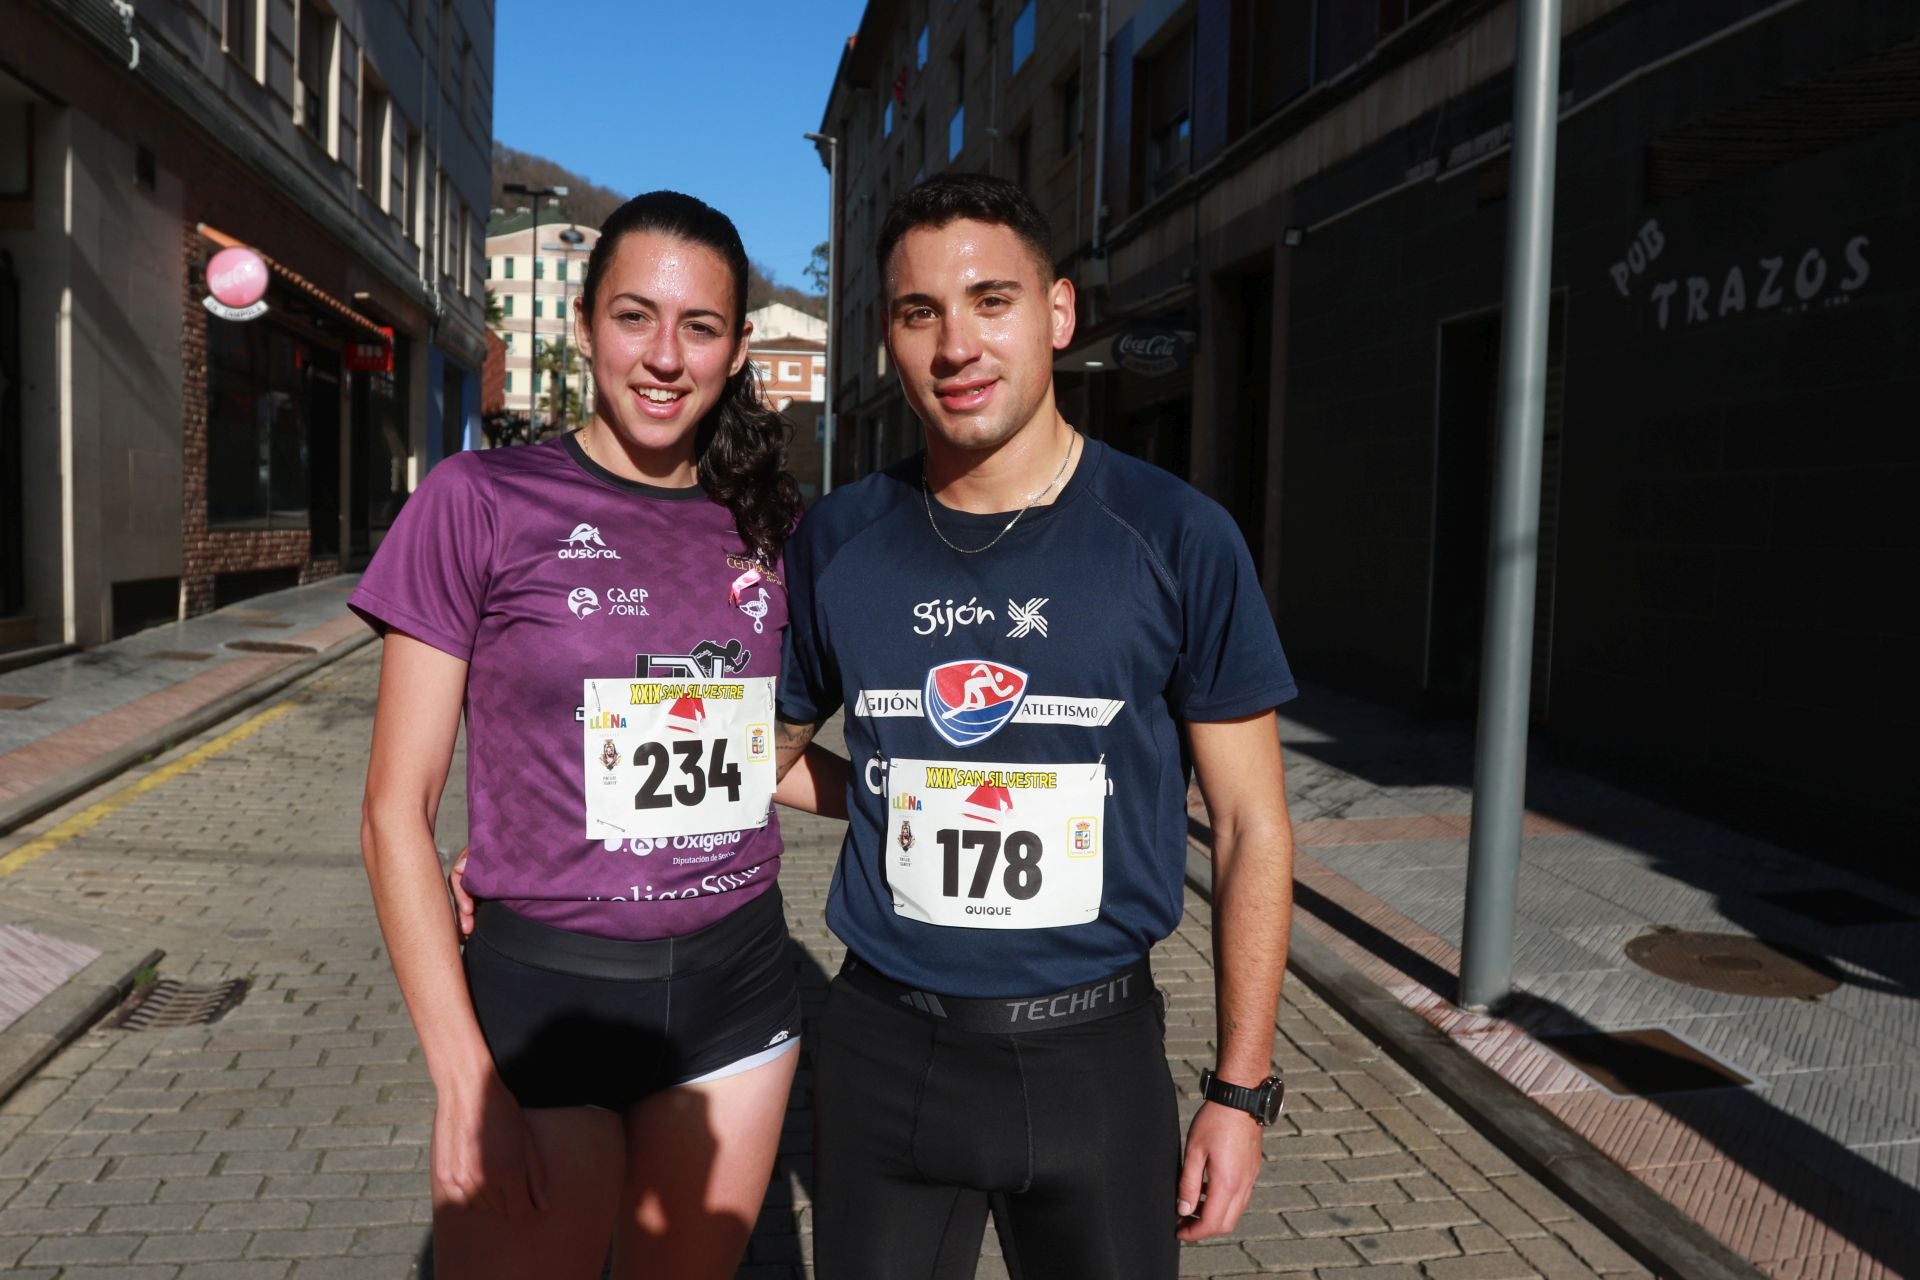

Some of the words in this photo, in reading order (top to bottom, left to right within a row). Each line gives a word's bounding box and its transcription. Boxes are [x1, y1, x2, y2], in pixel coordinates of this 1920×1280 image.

[1608, 218, 1666, 297] PUB
[1650, 234, 1872, 331] TRAZOS
[630, 684, 661, 705] XXIX
[661, 684, 685, 700] SAN
[686, 684, 745, 700] SILVESTRE
[867, 692, 919, 713] GIJÓN
[589, 711, 627, 729] LLENA
[1021, 703, 1099, 719] ATLETISMO
[633, 738, 742, 810] 234
[926, 767, 958, 789] XXIX
[957, 770, 985, 787] SAN
[988, 770, 1058, 789] SILVESTRE
[892, 791, 923, 811] LLENA
[672, 855, 710, 866] Diputación
[710, 853, 719, 862] de
[936, 828, 1043, 900] 178
[965, 905, 1012, 916] QUIQUE
[1006, 973, 1134, 1023] TECHFIT
